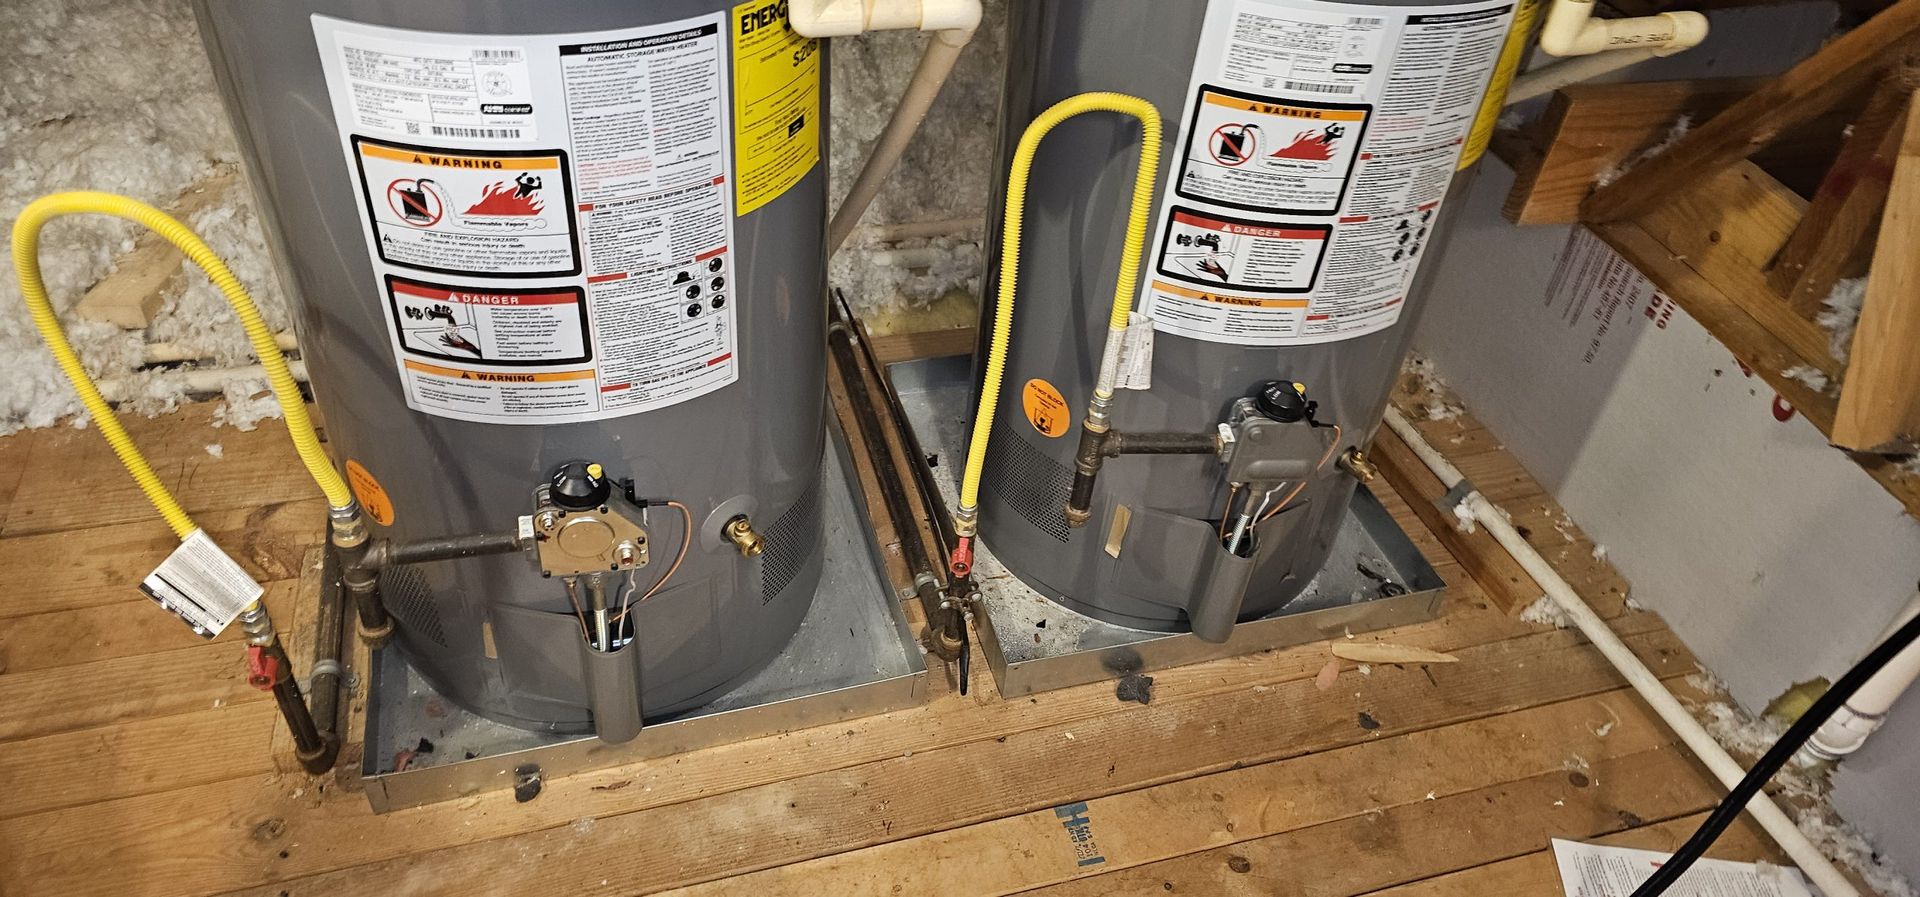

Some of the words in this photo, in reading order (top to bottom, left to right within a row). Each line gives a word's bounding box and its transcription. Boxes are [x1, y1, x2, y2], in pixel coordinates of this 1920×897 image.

[580, 42, 628, 52] INSTALLATION
[628, 40, 642, 48] AND
[644, 34, 678, 46] OPERATION
[679, 30, 702, 40] DETAILS
[588, 54, 624, 62] AUTOMATIC
[626, 50, 654, 58] STORAGE
[677, 42, 698, 50] HEATER
[1264, 105, 1322, 118] WARNING
[430, 156, 502, 169] WARNING
[664, 190, 683, 198] BEFORE
[686, 182, 712, 192] OPERATING
[1234, 226, 1281, 237] DANGER
[630, 268, 655, 278] LIGHTING
[656, 260, 692, 272] INSTRUCTIONS
[462, 294, 519, 305] DANGER
[1215, 296, 1262, 306] WARNING
[1604, 296, 1621, 326] Report
[685, 364, 706, 374] APPLIANCE
[476, 374, 534, 382] WARNING
[1047, 394, 1064, 407] BLOCK
